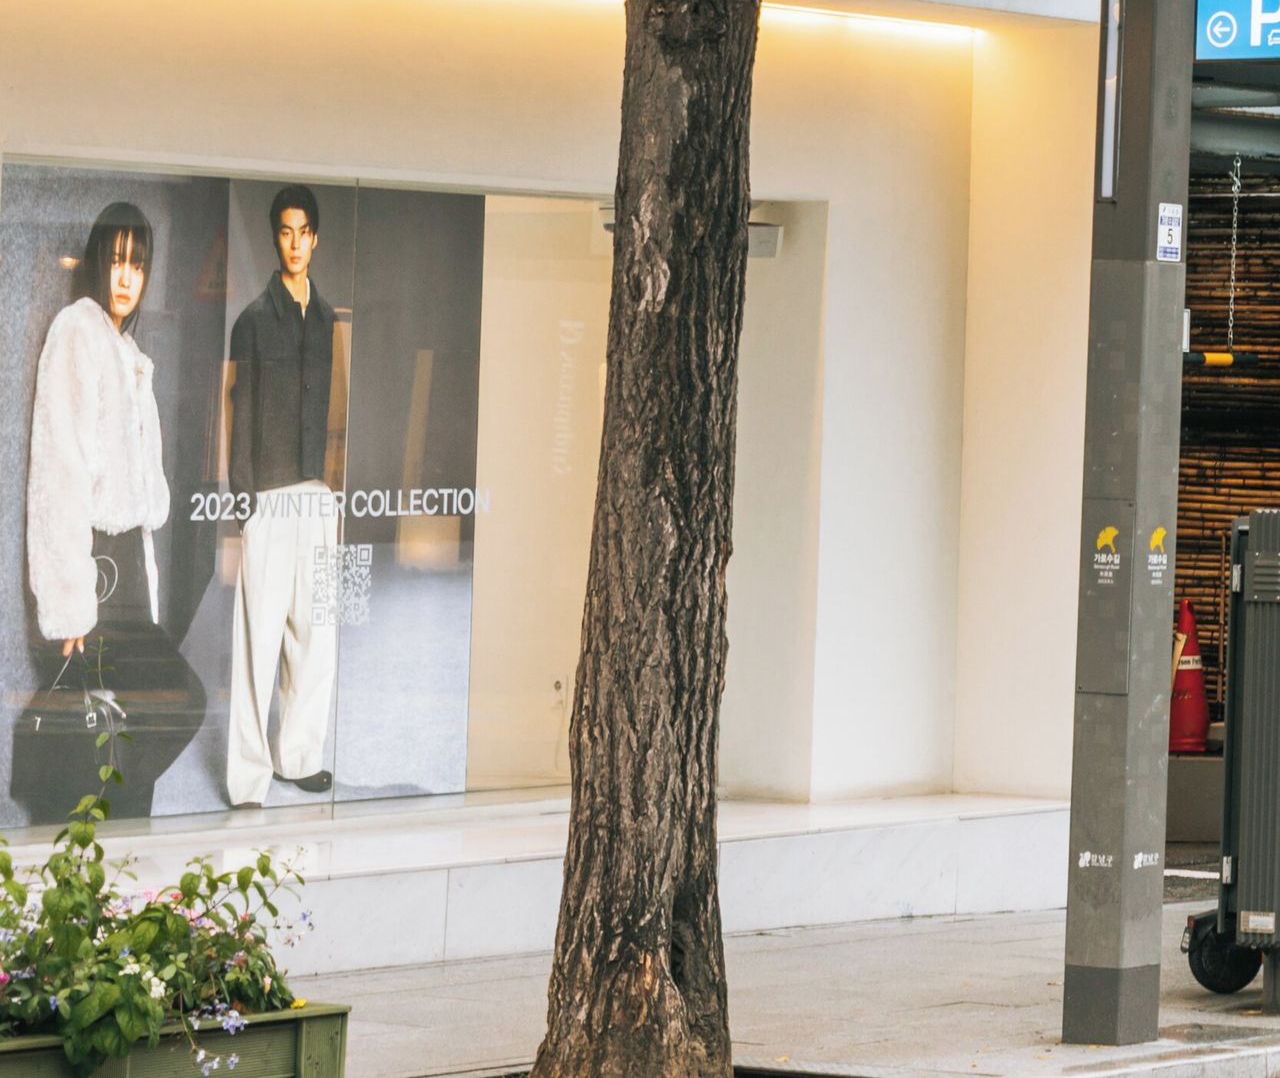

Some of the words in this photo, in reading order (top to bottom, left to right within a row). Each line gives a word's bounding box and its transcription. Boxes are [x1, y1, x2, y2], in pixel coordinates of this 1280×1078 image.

[1167, 228, 1174, 245] 5
[190, 492, 250, 521] 2023
[255, 491, 346, 519] WINTER
[351, 487, 493, 517] COLLECTION
[1094, 553, 1121, 565] 가로수길
